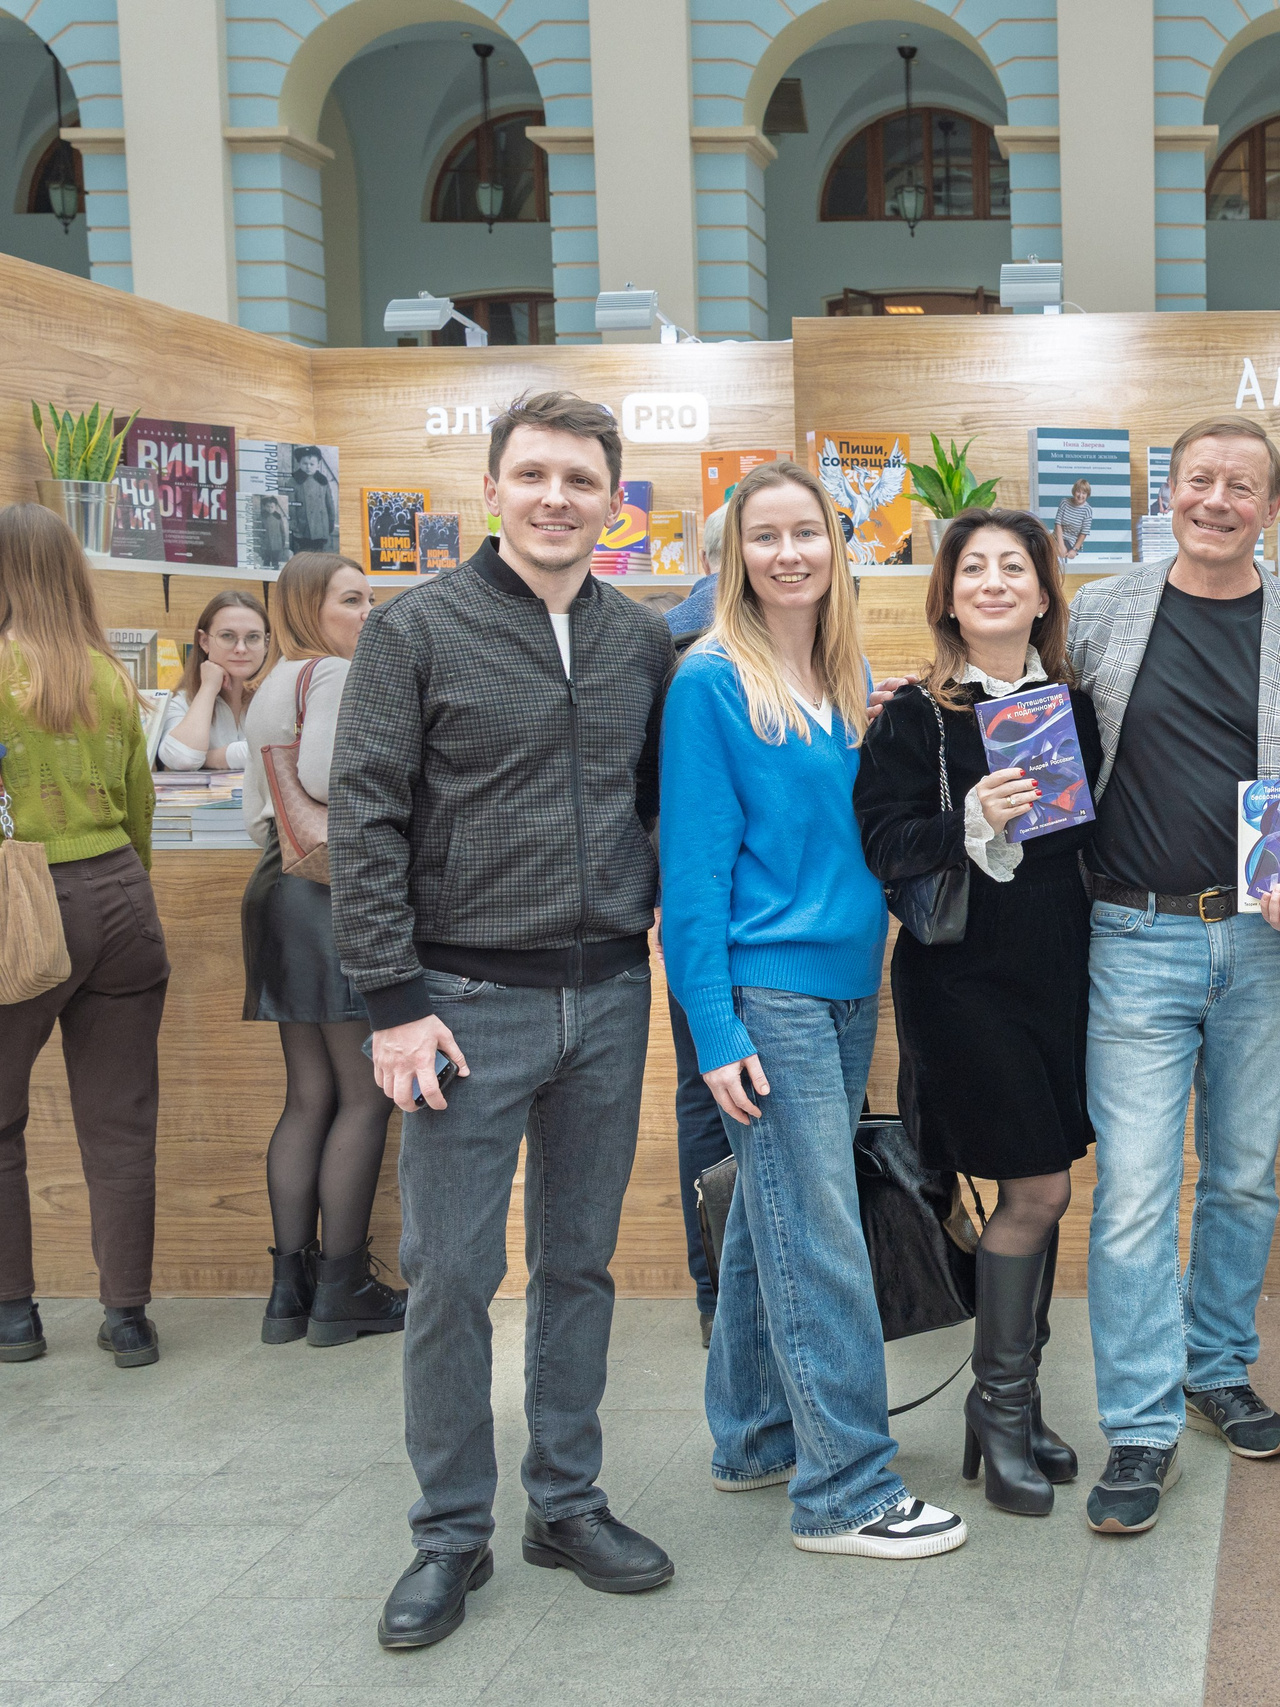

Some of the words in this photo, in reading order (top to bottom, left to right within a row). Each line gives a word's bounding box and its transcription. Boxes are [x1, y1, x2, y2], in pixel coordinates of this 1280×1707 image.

[634, 404, 698, 430] PRO
[839, 441, 888, 457] Пиши,
[1080, 441, 1105, 450] Зверева
[137, 439, 229, 486] ВИНО
[264, 444, 279, 492] ПРАВИЛА
[822, 455, 901, 470] сокращай
[159, 484, 228, 521] ОГИЯ
[380, 536, 410, 549] HOMO
[1014, 702, 1057, 718] подлинному
[1058, 698, 1065, 706] Я
[1016, 693, 1063, 710] Путешествие
[1029, 762, 1049, 772] Андрей
